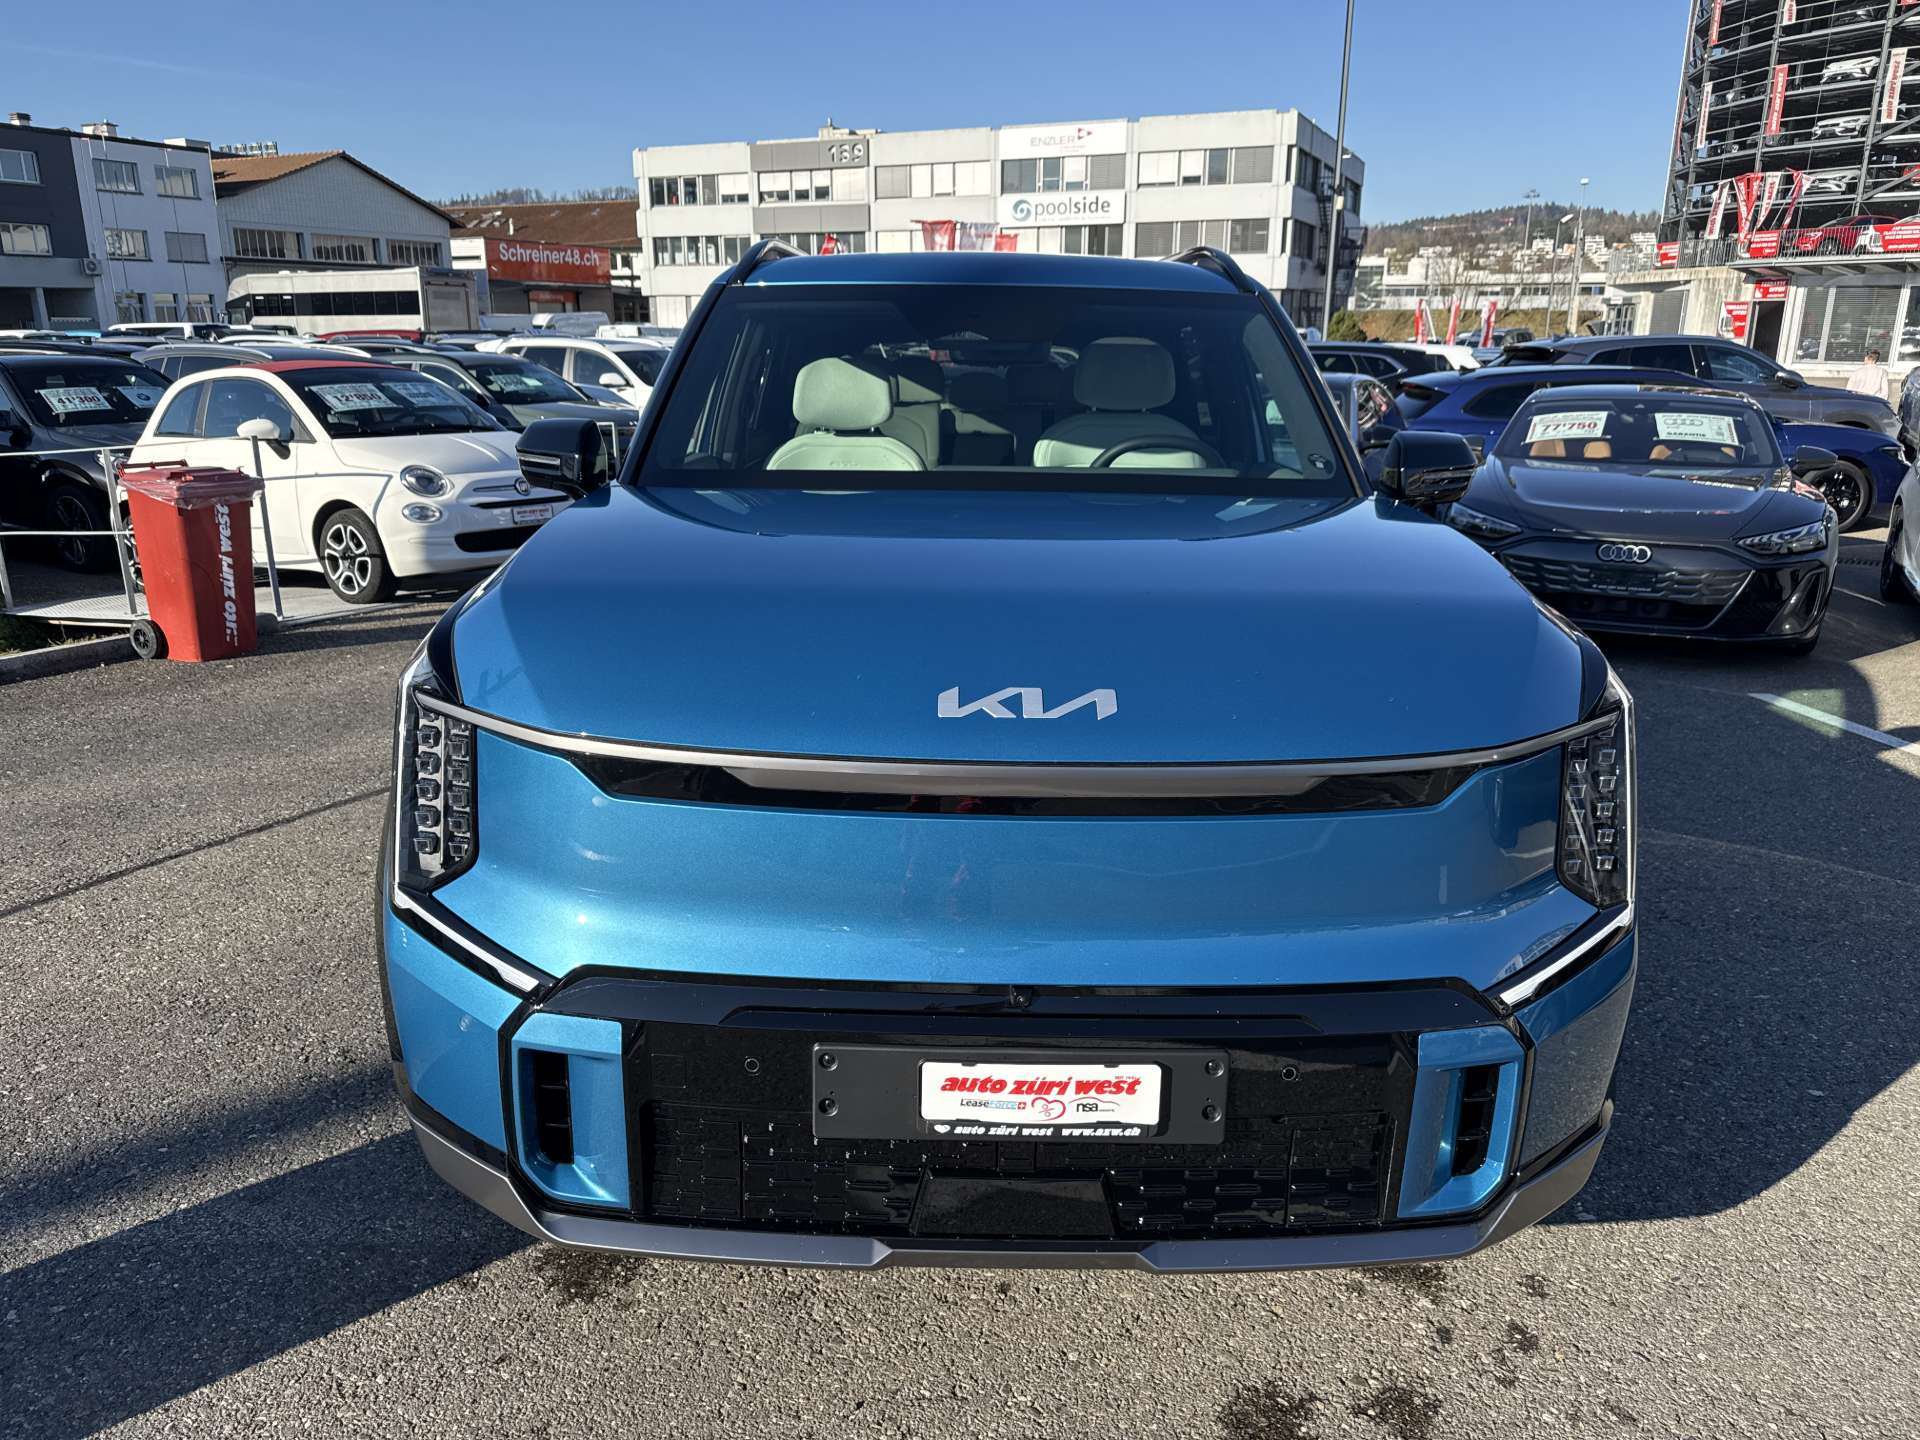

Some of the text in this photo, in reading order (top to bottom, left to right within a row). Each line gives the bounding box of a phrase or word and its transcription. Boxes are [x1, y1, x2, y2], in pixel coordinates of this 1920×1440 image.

[1030, 135, 1075, 147] ENZLER
[1035, 195, 1111, 222] poolside
[499, 241, 600, 267] Schreiner48.ch
[1541, 421, 1598, 432] 77'750
[215, 502, 233, 552] west
[218, 554, 236, 600] züri
[937, 686, 1118, 721] KIA
[940, 1075, 1142, 1096] auto züri west
[1076, 1102, 1099, 1113] nsa
[953, 1125, 986, 1135] auto
[987, 1125, 1020, 1136] züri
[1021, 1127, 1054, 1137] west
